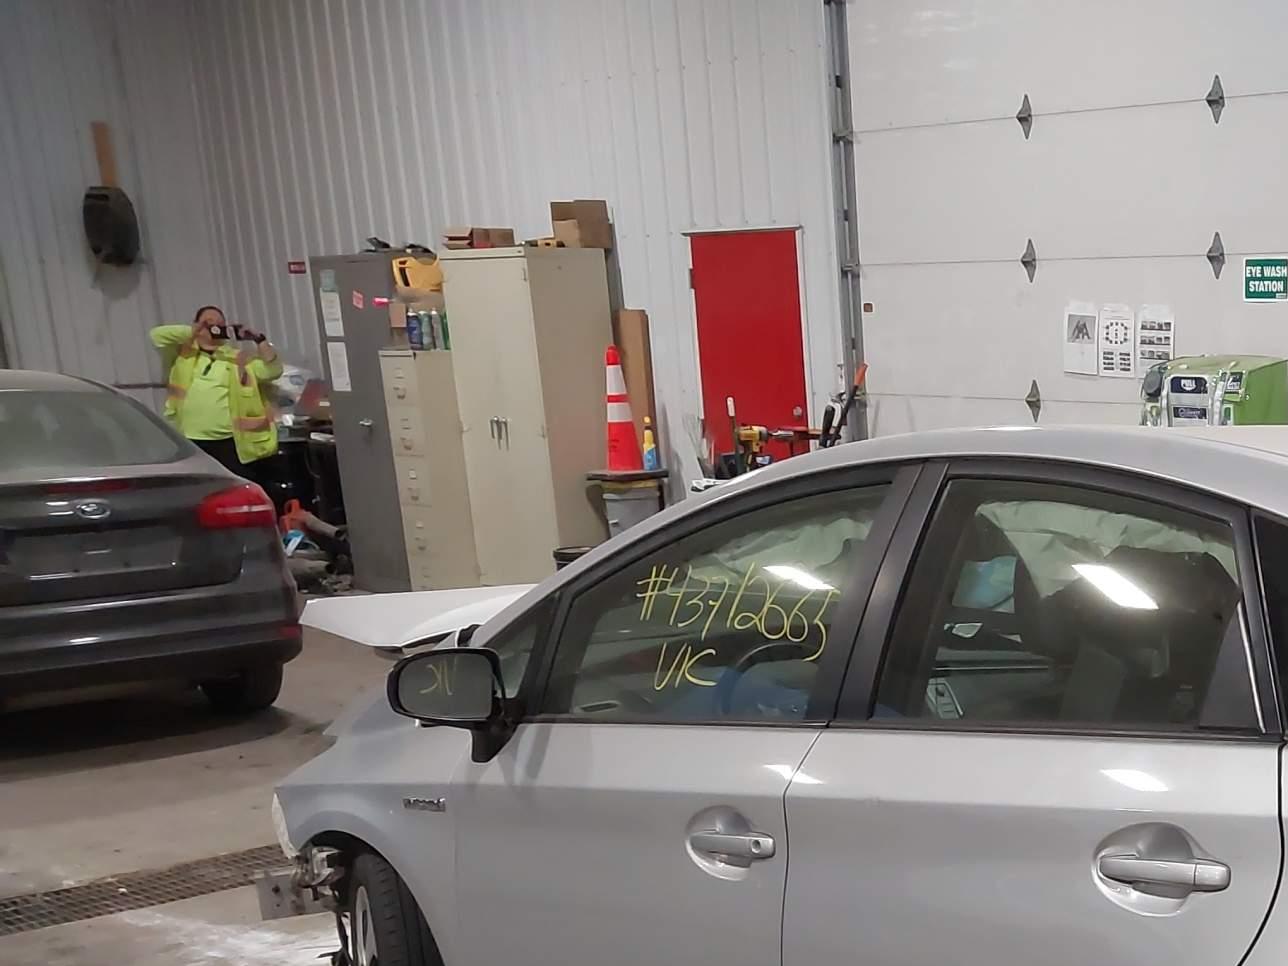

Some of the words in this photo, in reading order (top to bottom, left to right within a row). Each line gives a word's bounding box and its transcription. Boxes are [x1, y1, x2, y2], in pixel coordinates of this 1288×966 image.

[1245, 265, 1262, 278] EYE
[1263, 265, 1288, 278] WASH
[1248, 279, 1284, 292] STATION
